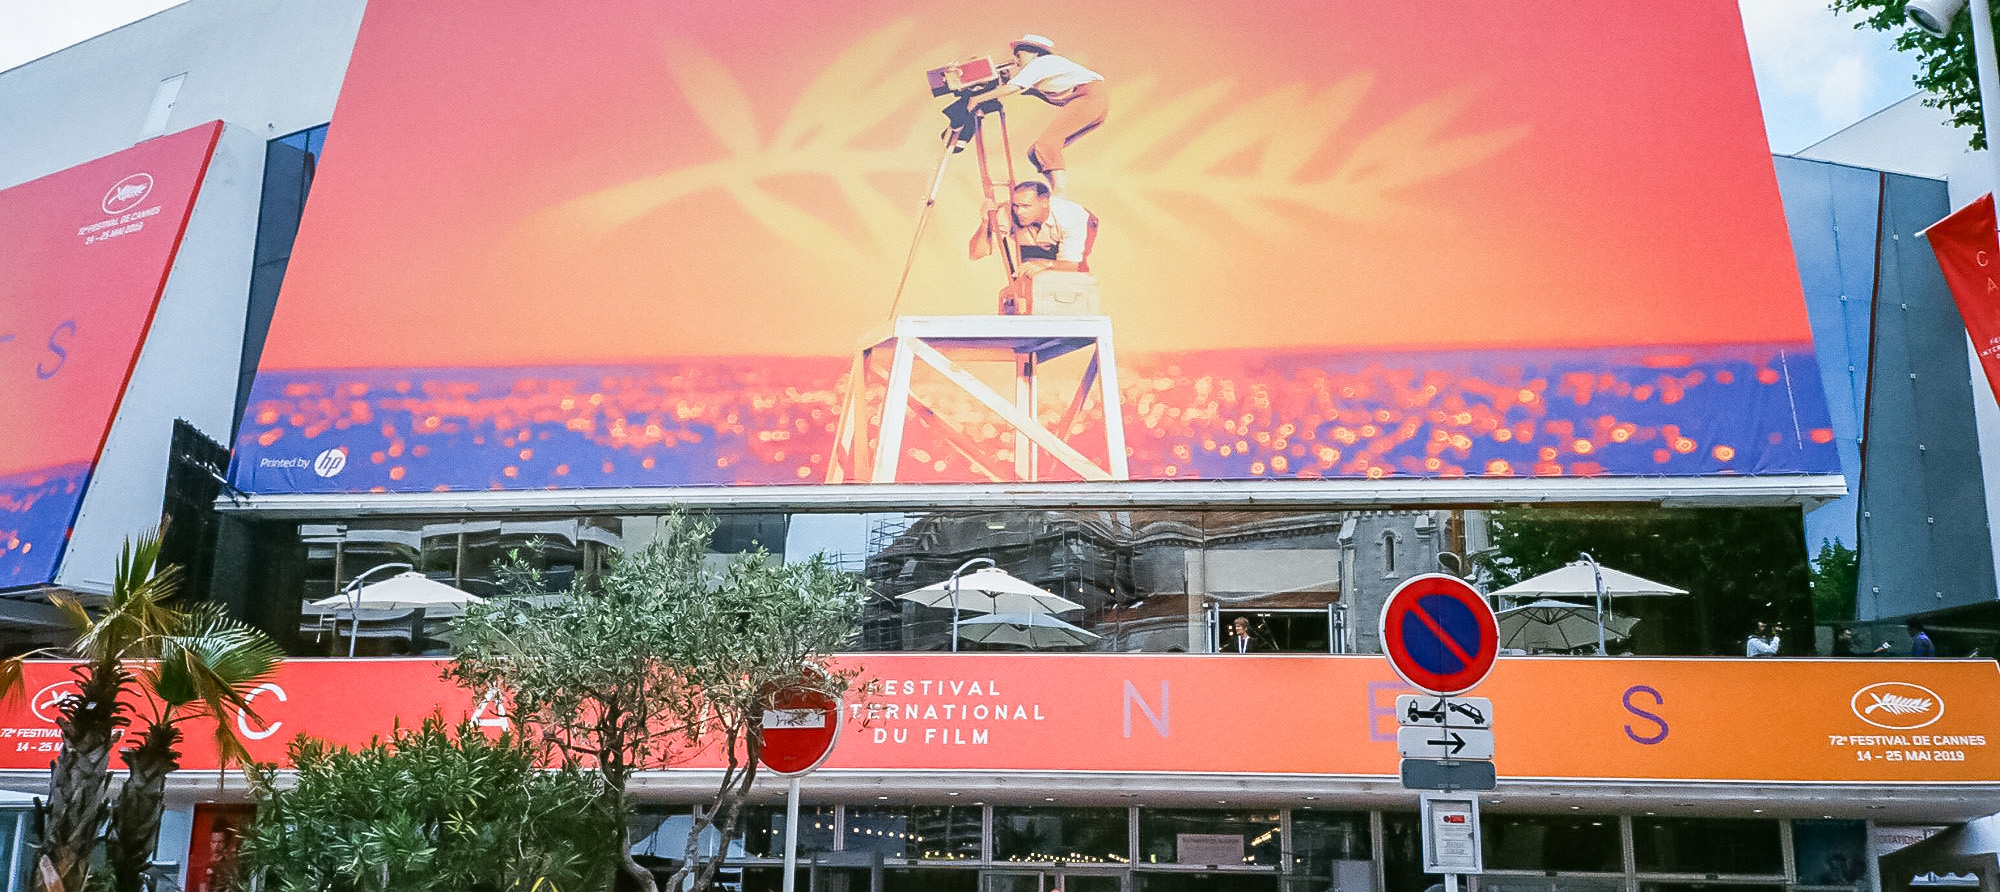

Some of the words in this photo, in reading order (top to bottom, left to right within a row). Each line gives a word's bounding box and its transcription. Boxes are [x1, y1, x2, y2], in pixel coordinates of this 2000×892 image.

[260, 458, 296, 468] Printed
[297, 457, 310, 469] by
[238, 683, 287, 740] C
[1123, 680, 1170, 738] N
[1367, 681, 1410, 742] E
[1622, 685, 1670, 745] S
[873, 728, 907, 744] DU
[925, 729, 989, 745] FILM
[1849, 735, 1911, 747] FESTIVAL
[1912, 736, 1931, 746] DE
[1933, 735, 1986, 747] CANNES
[16, 742, 29, 752] 14
[37, 742, 52, 752] 25
[1856, 751, 1872, 762] 14
[1885, 751, 1902, 761] 25
[1905, 751, 1932, 762] MAI
[1933, 751, 1965, 762] 2019
